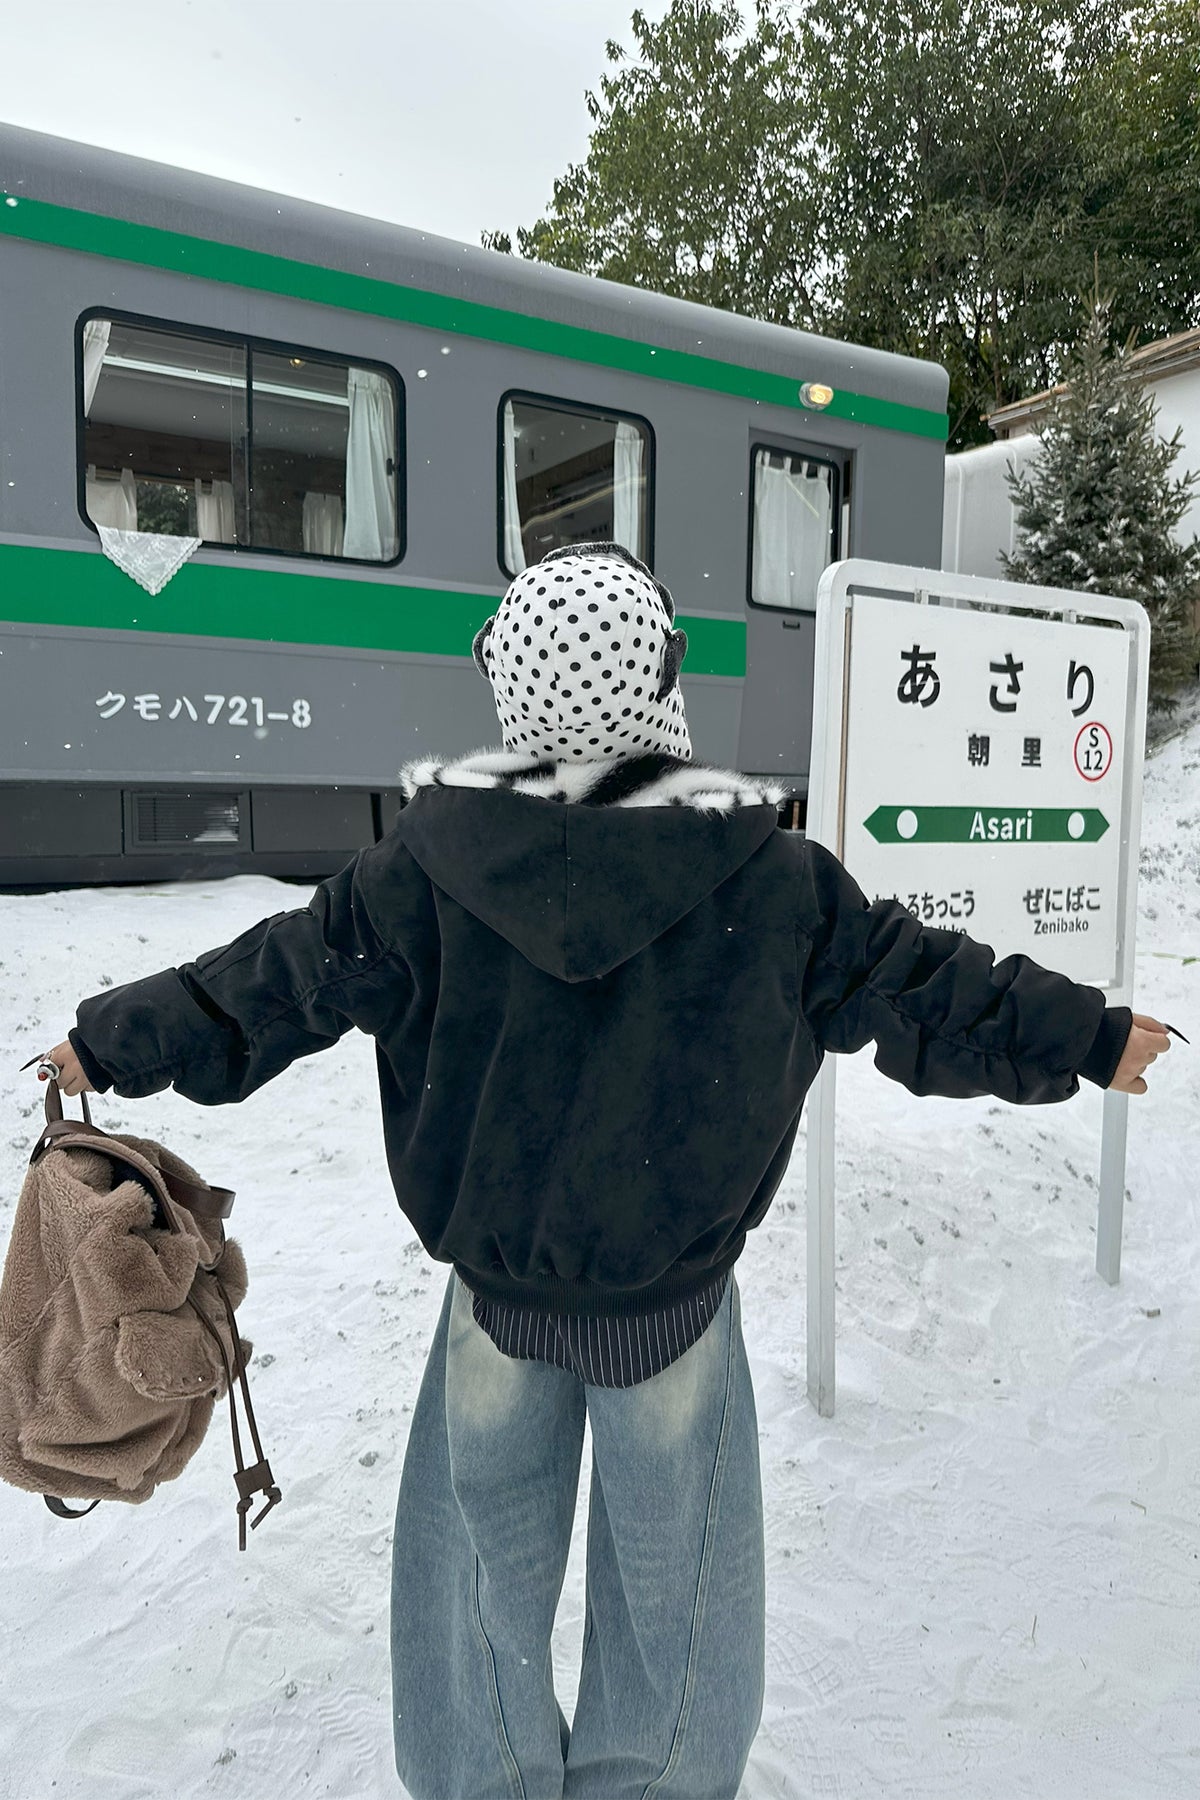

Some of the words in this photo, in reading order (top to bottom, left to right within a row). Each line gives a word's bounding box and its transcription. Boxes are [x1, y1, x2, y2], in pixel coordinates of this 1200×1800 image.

[897, 645, 1094, 717] あさり
[95, 691, 311, 728] クモハ721-8
[967, 734, 1042, 767] 朝里
[1088, 728, 1099, 748] S
[1083, 751, 1103, 771] 12
[969, 811, 1033, 841] Asari
[1022, 886, 1101, 915] ぜにばこ
[1033, 918, 1089, 935] Zenibako
